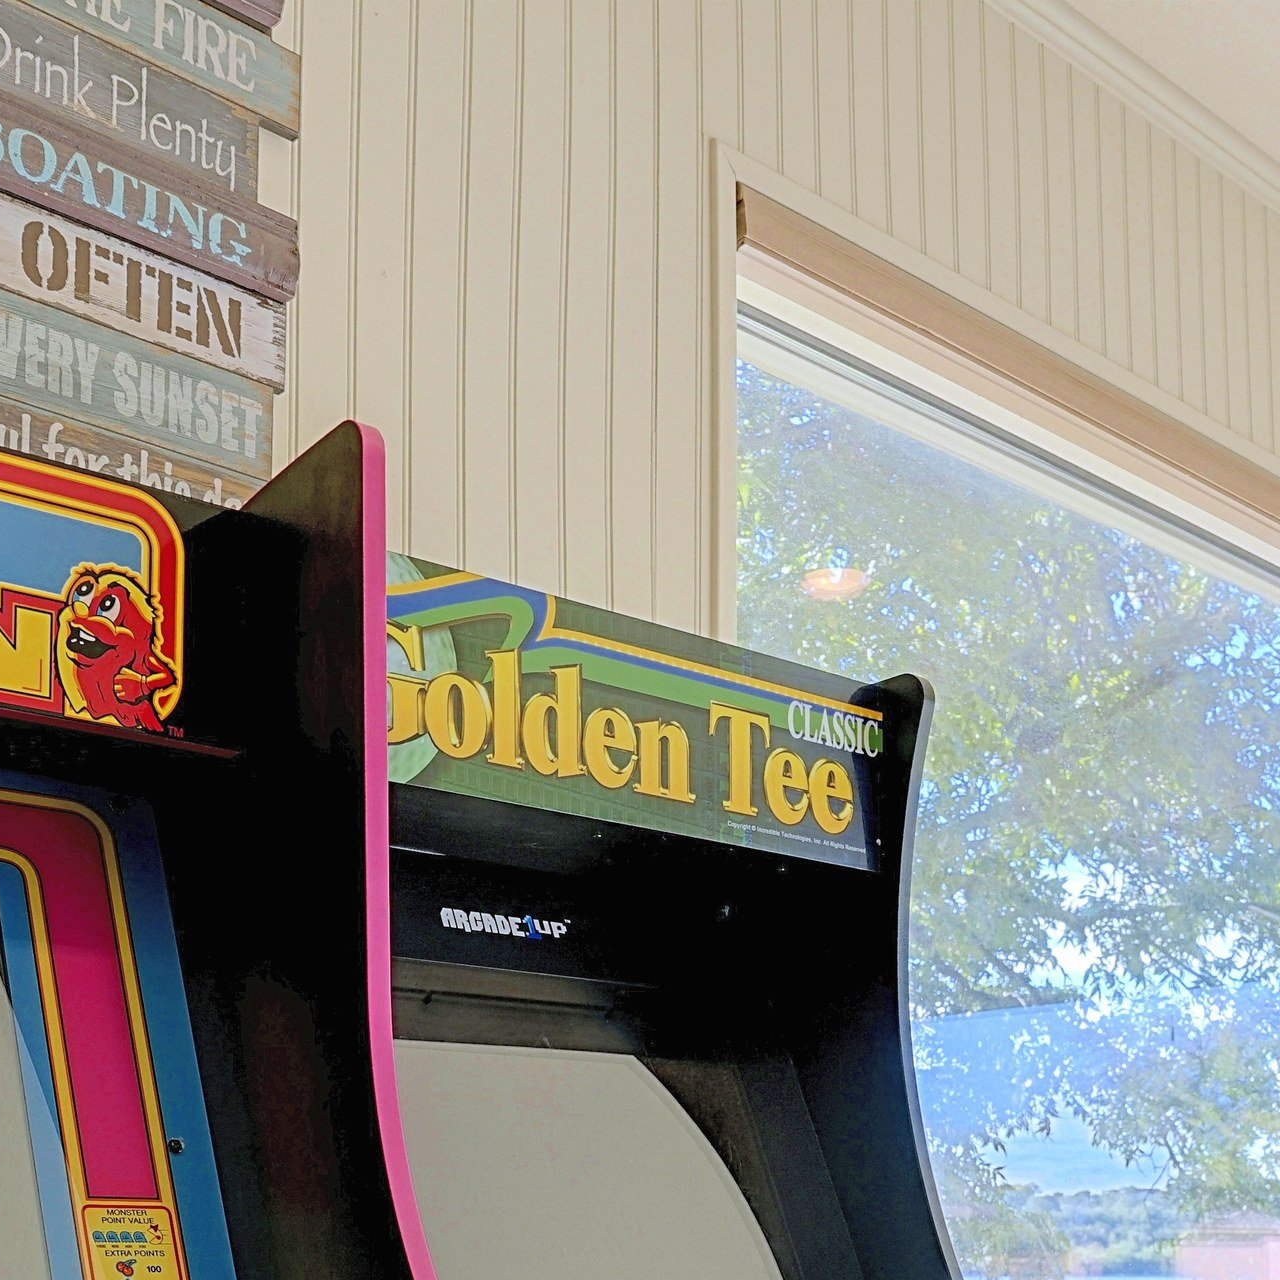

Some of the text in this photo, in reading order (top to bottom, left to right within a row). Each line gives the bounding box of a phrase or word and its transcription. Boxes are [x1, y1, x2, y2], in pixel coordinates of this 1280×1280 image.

[152, 0, 257, 93] FIRE
[110, 66, 238, 191] Plenty
[21, 220, 243, 360] OFTEN
[113, 350, 263, 459] SUNSET
[708, 699, 855, 836] Tee
[788, 699, 880, 758] CLASSIC
[727, 820, 752, 831] Copyright
[146, 1265, 162, 1273] 100
